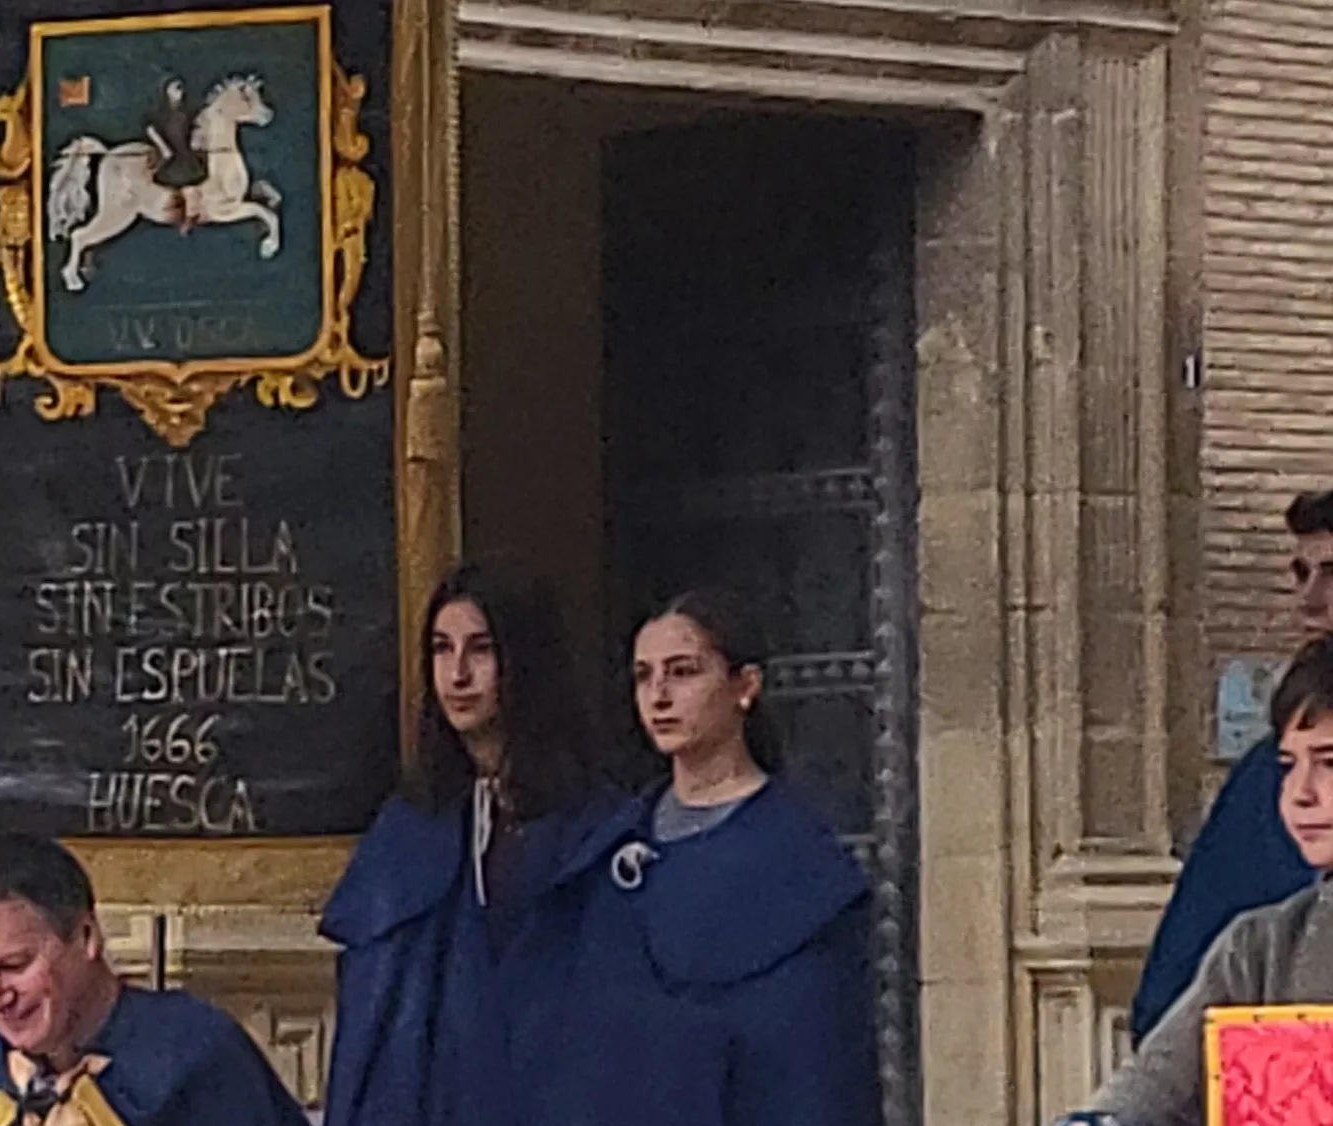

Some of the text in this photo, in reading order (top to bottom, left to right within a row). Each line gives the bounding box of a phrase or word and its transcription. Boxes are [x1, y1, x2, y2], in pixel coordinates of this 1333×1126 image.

[114, 453, 245, 508] VIVE
[70, 517, 298, 575] SIN SILLA
[35, 580, 333, 638] SIN ESTRIBOS
[27, 645, 336, 703] SIN ESPUELAS
[120, 712, 223, 765] 1666
[88, 771, 259, 833] HUESCA
